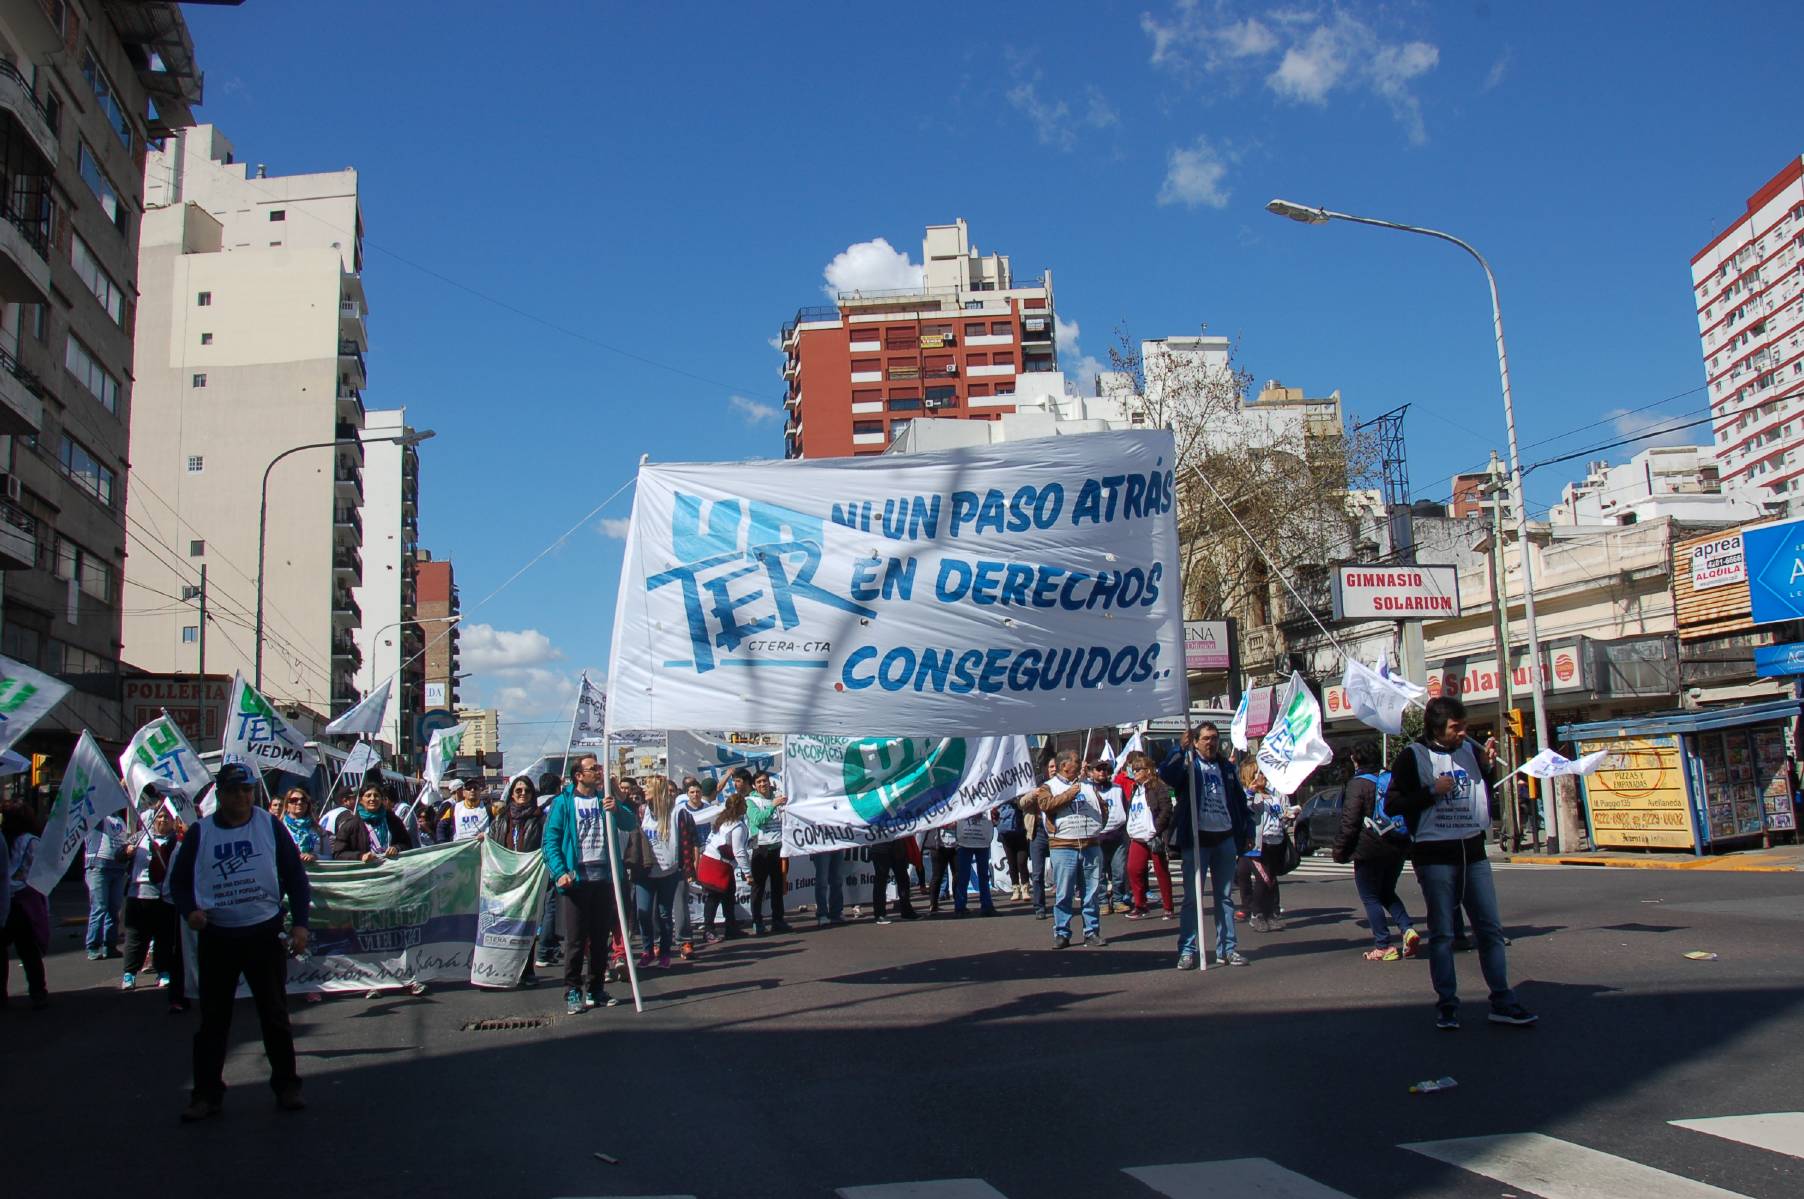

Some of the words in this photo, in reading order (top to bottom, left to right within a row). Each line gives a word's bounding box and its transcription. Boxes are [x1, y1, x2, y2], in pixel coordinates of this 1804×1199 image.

[884, 494, 940, 540] UN
[951, 484, 1065, 538] PASO
[1072, 456, 1175, 526] ATRÁS
[1694, 536, 1741, 559] aprea
[1347, 574, 1422, 587] GIMNASIO
[1696, 565, 1741, 581] ALQUILA
[851, 556, 917, 601] EN
[936, 558, 1163, 610] DERECHOS
[646, 539, 878, 674] TER
[1373, 596, 1452, 610] SOLARIUM
[748, 640, 831, 654] CTERA-CTA
[237, 712, 294, 745] TER
[247, 741, 303, 764] VIEDMA
[1613, 780, 1648, 789] EMPANADAS
[1615, 772, 1639, 780] PIZZAS
[1647, 799, 1682, 807] Avellaneda
[793, 825, 854, 848] COMALLO
